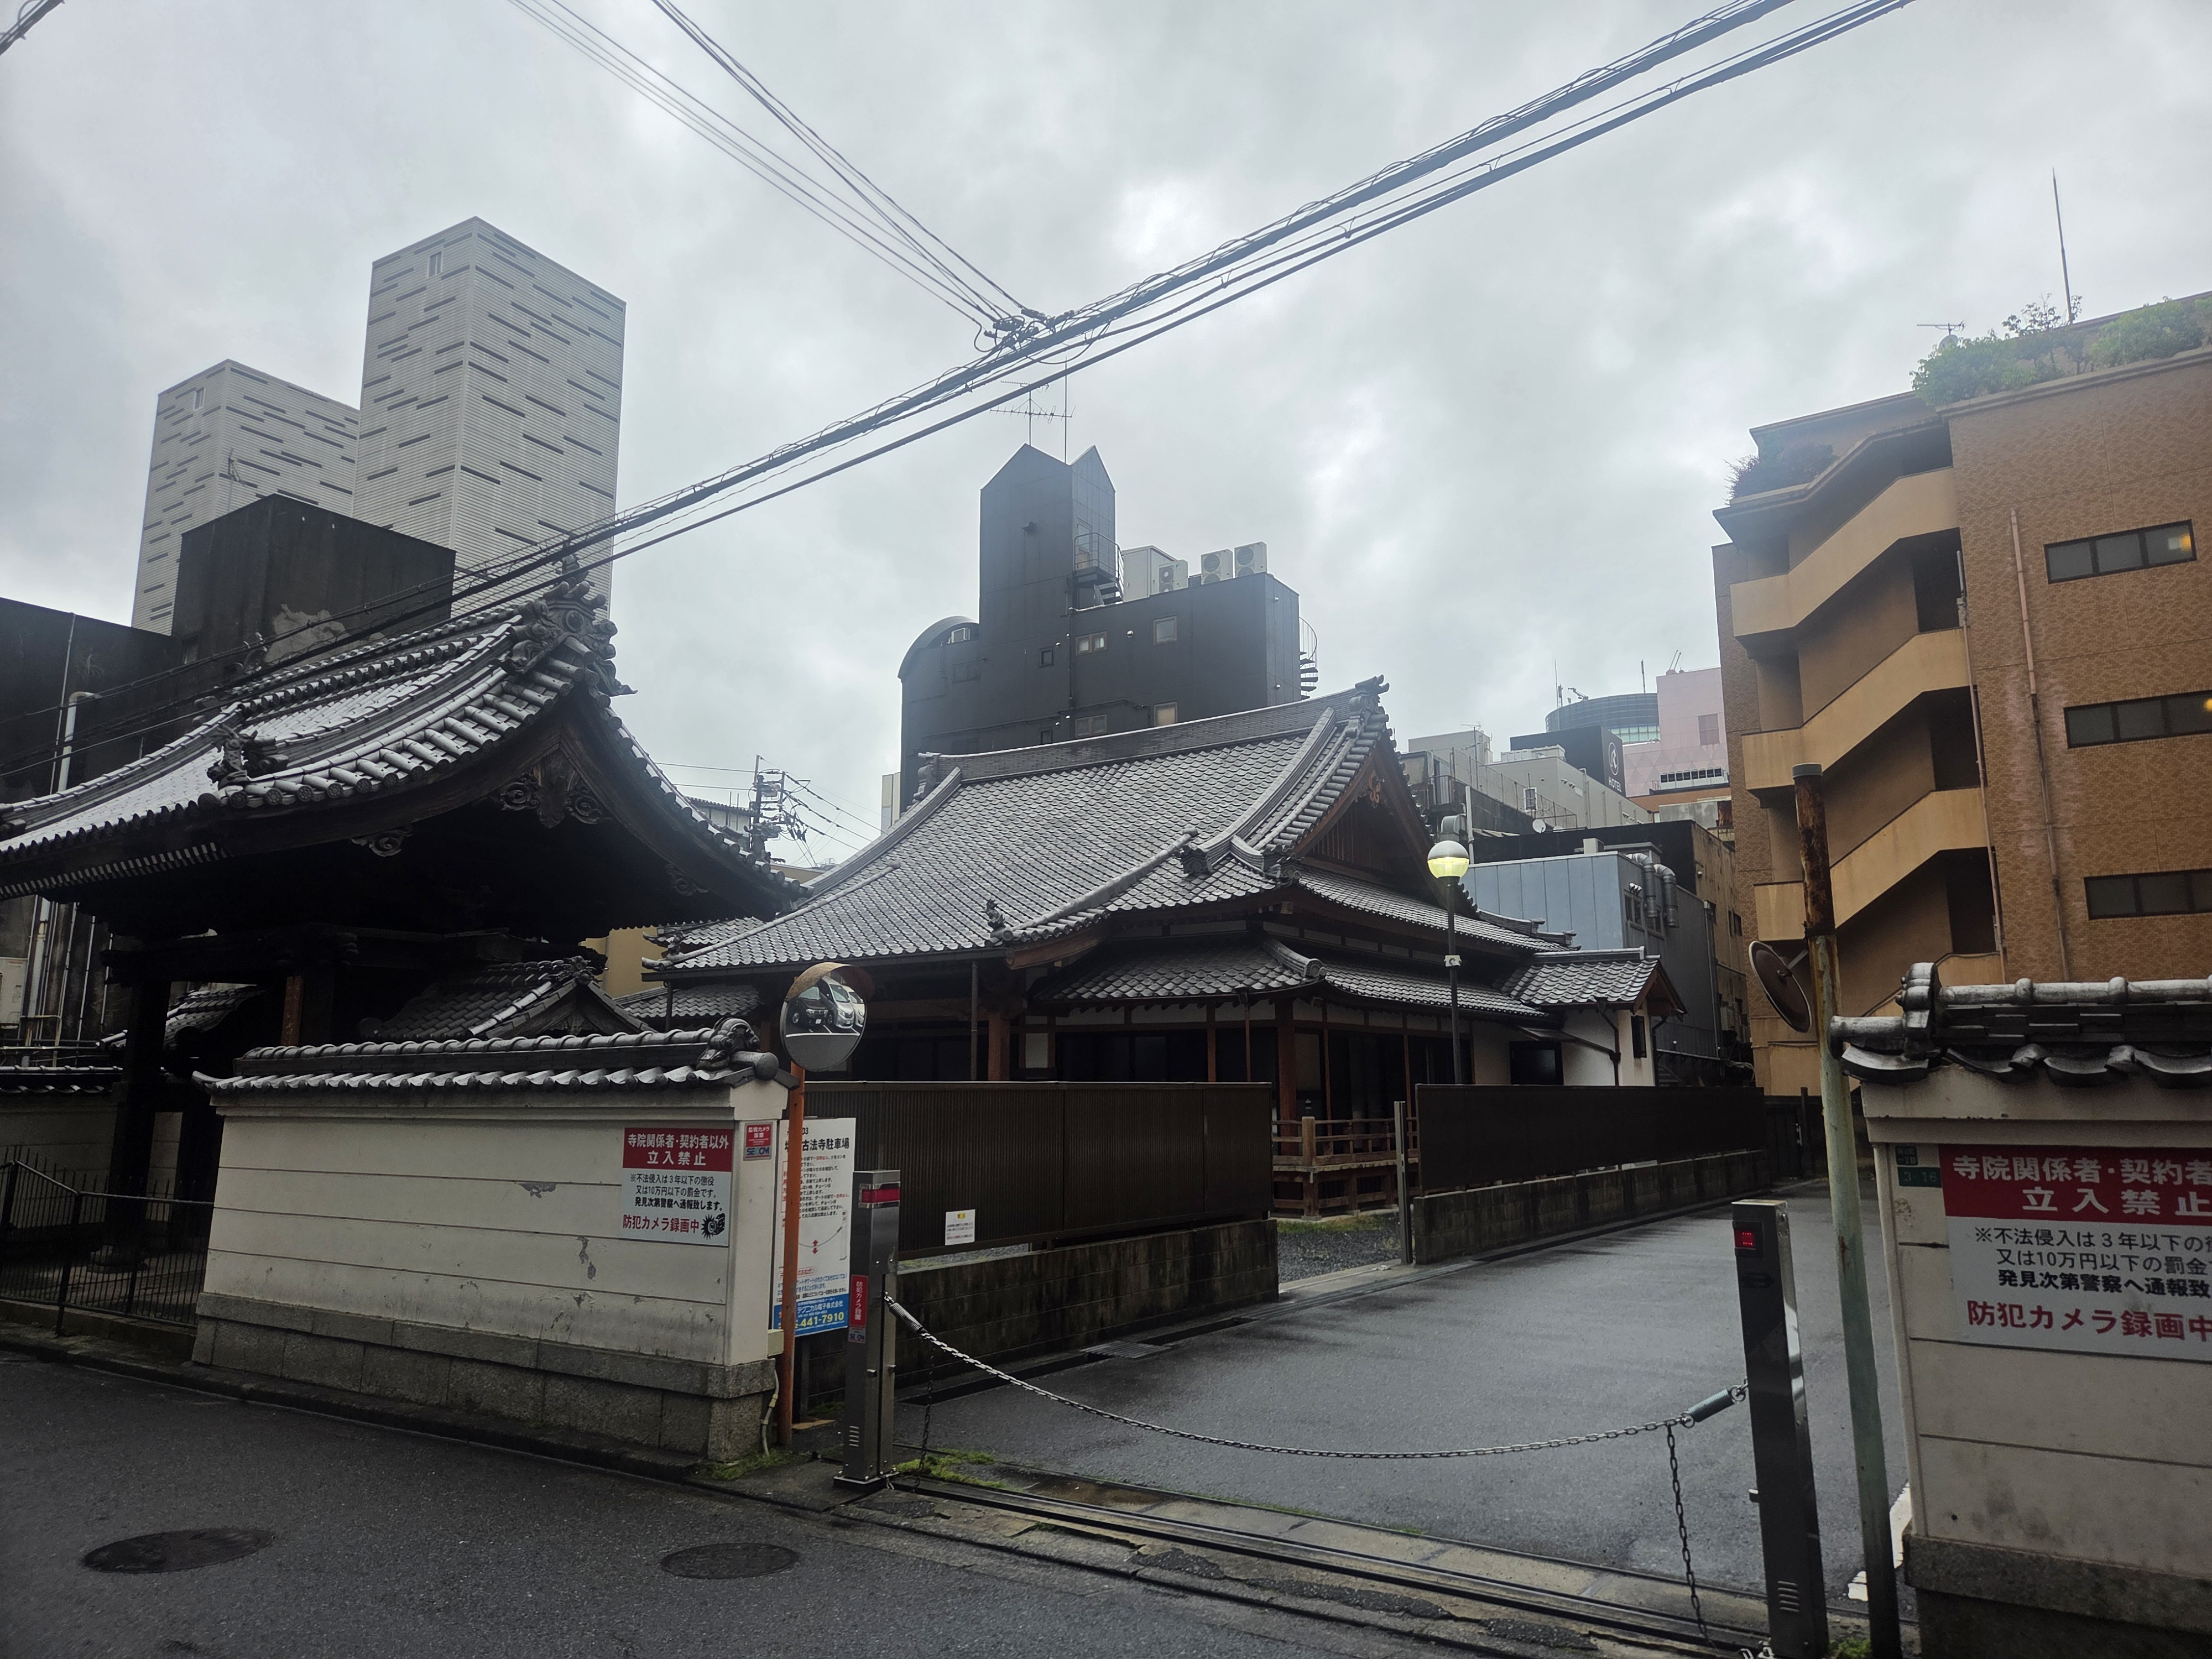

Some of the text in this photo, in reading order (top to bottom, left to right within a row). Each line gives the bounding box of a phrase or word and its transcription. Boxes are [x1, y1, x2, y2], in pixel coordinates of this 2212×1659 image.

[1608, 776, 1622, 792] HOTEL
[647, 1150, 706, 1166] 立入禁止
[747, 1147, 770, 1156] SECOM
[2022, 1186, 2212, 1217] 立入禁止
[623, 1214, 699, 1234] 防犯カメラ録画中
[1997, 1248, 2212, 1276] 又は10万円以下の罰金
[1999, 1269, 2210, 1299] 発見次第警察へ通報致
[1967, 1300, 2212, 1342] 防犯カメラ録画中
